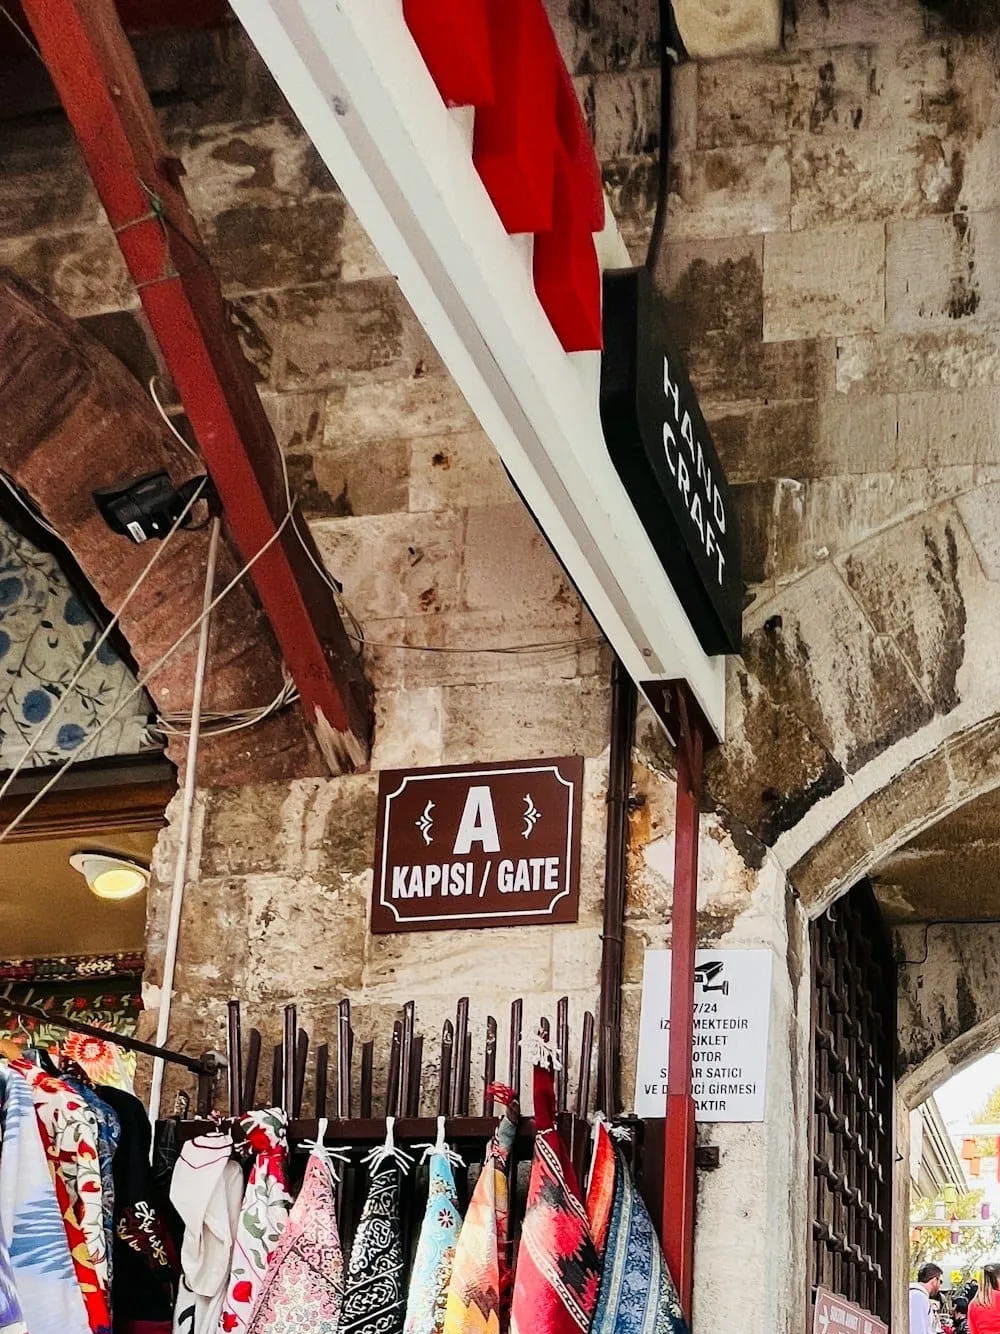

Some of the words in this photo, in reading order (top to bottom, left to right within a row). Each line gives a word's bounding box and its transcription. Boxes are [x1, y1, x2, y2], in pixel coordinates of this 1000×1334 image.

[663, 356, 726, 535] HAND
[663, 421, 726, 586] CRAFT
[453, 786, 501, 855] A
[392, 862, 474, 899] KAPISI
[478, 860, 492, 898] /
[497, 857, 560, 893] GATE
[692, 1003, 718, 1013] 7/24
[660, 1017, 748, 1030] İZMEKTEDİR
[692, 1033, 728, 1046] SİKLET
[692, 1051, 722, 1062] OTOR
[706, 1068, 742, 1079] SATICI
[644, 1084, 658, 1095] VE
[709, 1082, 756, 1095] GİRMESİ
[695, 1100, 726, 1111] AKTIR
